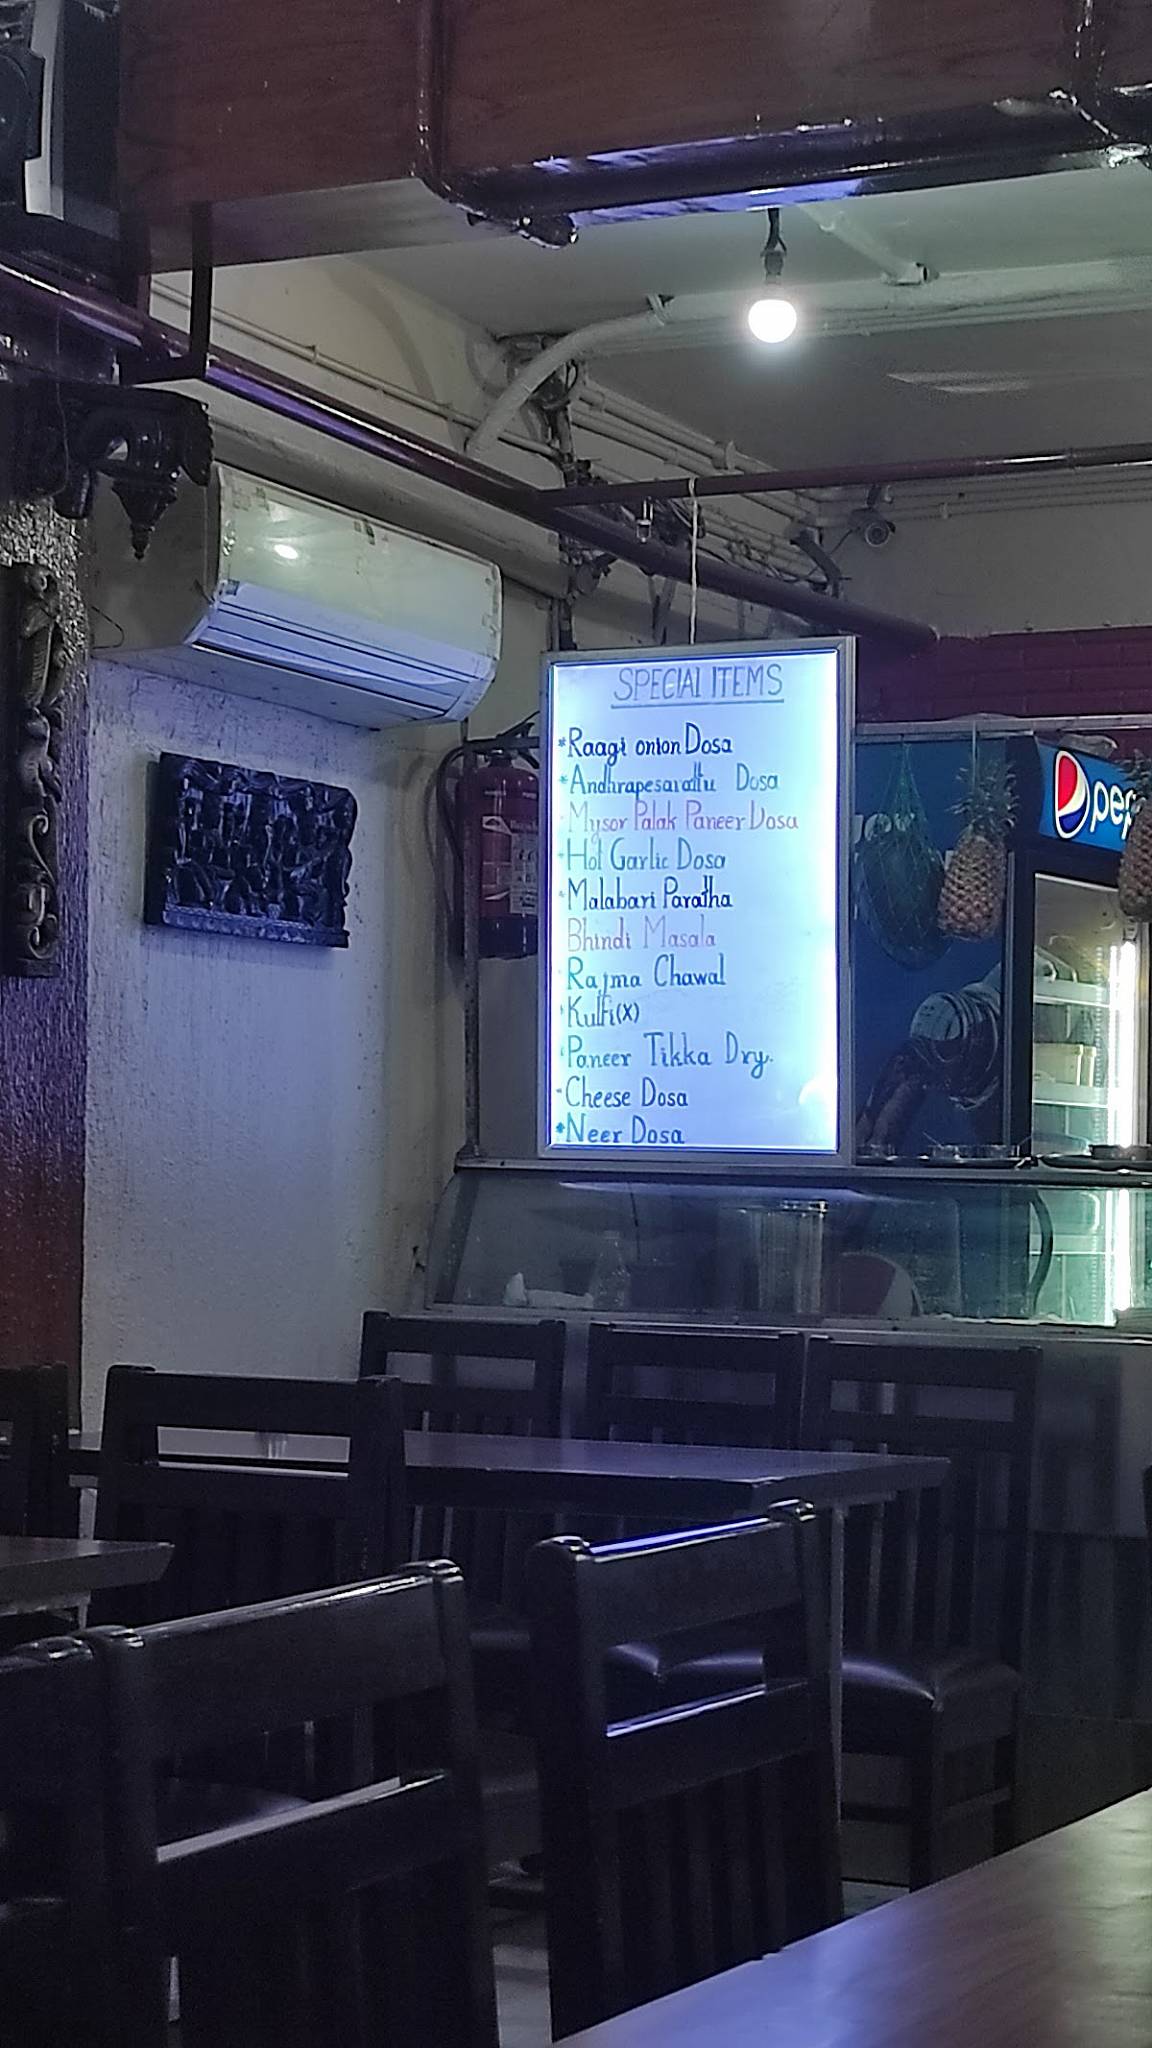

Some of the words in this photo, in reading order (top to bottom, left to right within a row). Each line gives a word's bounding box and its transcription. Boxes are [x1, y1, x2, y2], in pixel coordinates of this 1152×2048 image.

[712, 664, 783, 697] ITEMS
[568, 727, 626, 766] Raagi
[636, 737, 680, 756] onion
[685, 722, 732, 754] Dosa
[736, 763, 778, 792] Dosa
[568, 801, 628, 844] Mysor
[634, 800, 676, 831] Palak
[686, 800, 746, 830] Paneer
[610, 838, 669, 870] Garlic
[677, 838, 726, 870] Dosa
[568, 878, 656, 910] Malabari
[663, 875, 733, 908] Paratha
[567, 918, 631, 952] Bhindi
[643, 914, 716, 949] Masala
[567, 956, 641, 996] Rajma
[654, 953, 726, 987] Chawal
[567, 1035, 632, 1068] Paneer
[644, 1032, 712, 1067] Tikka
[566, 1076, 630, 1108] Cheese
[642, 1076, 688, 1106] Dosa
[566, 1112, 622, 1143] Neer
[632, 1115, 685, 1144] Dosa
